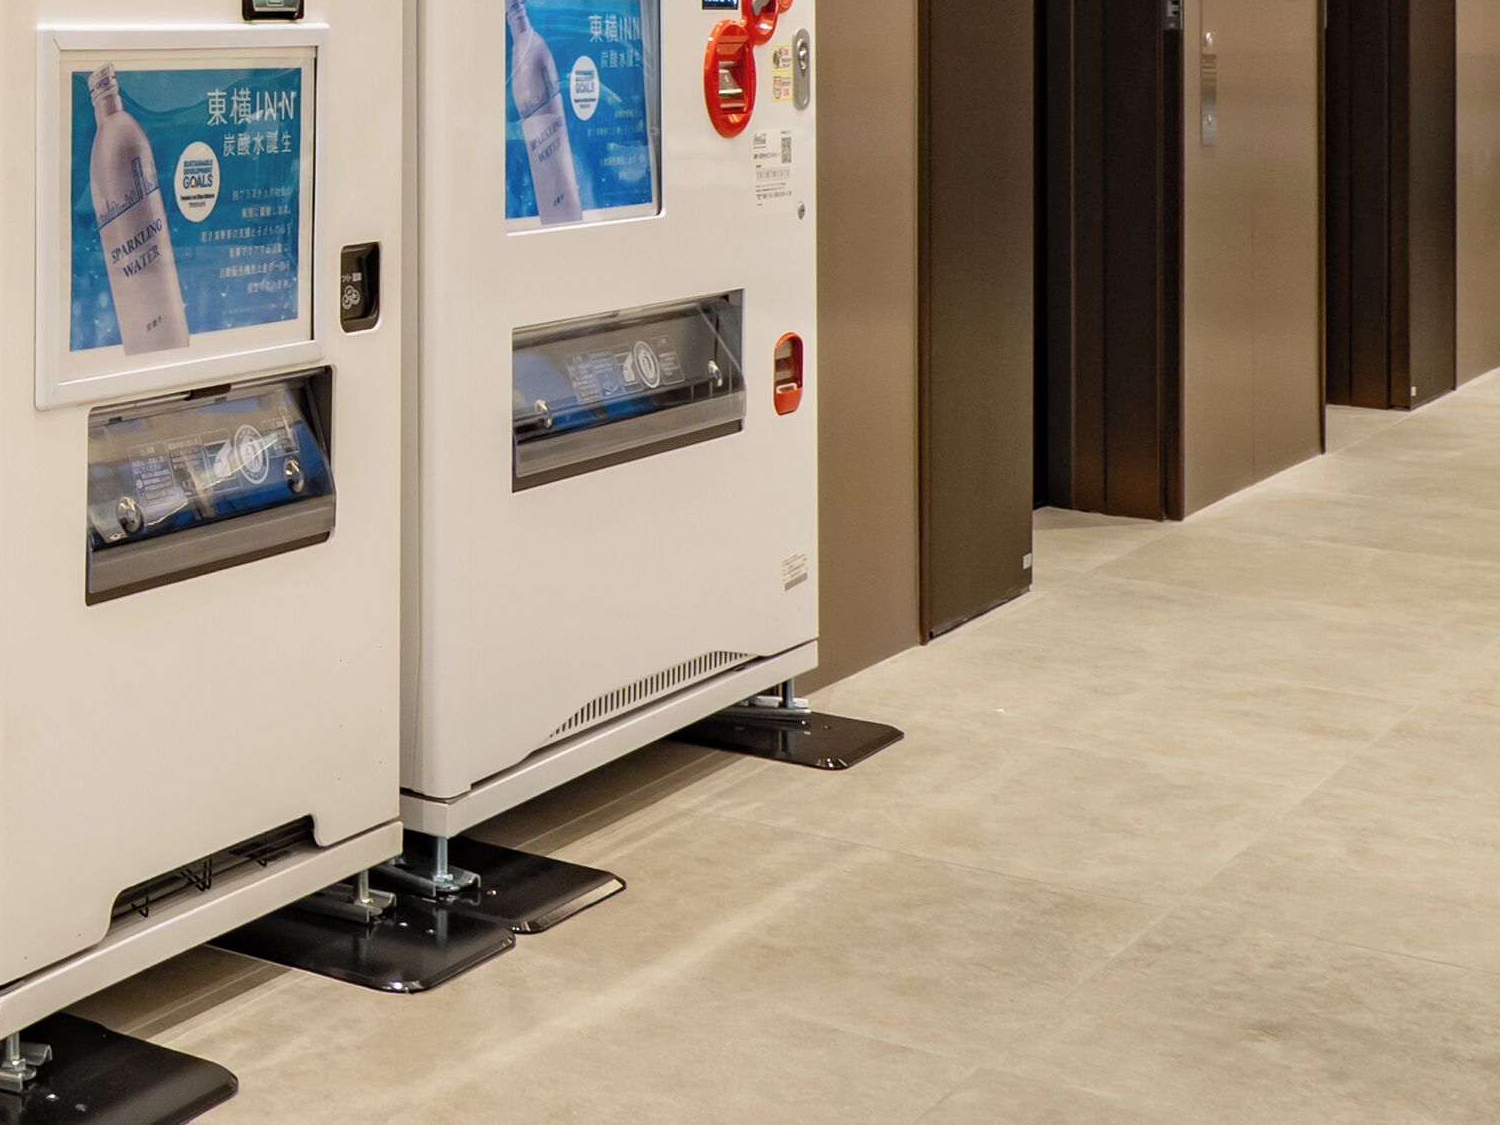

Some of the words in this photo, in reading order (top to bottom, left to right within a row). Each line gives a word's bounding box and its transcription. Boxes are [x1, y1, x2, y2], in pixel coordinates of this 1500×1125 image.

[588, 13, 640, 44] 東横INN
[206, 88, 297, 127] 東横INN
[222, 130, 293, 157] 炭酸水誕生
[183, 174, 213, 189] GOALS
[110, 217, 164, 265] SPARKLING
[122, 244, 161, 278] WATER
